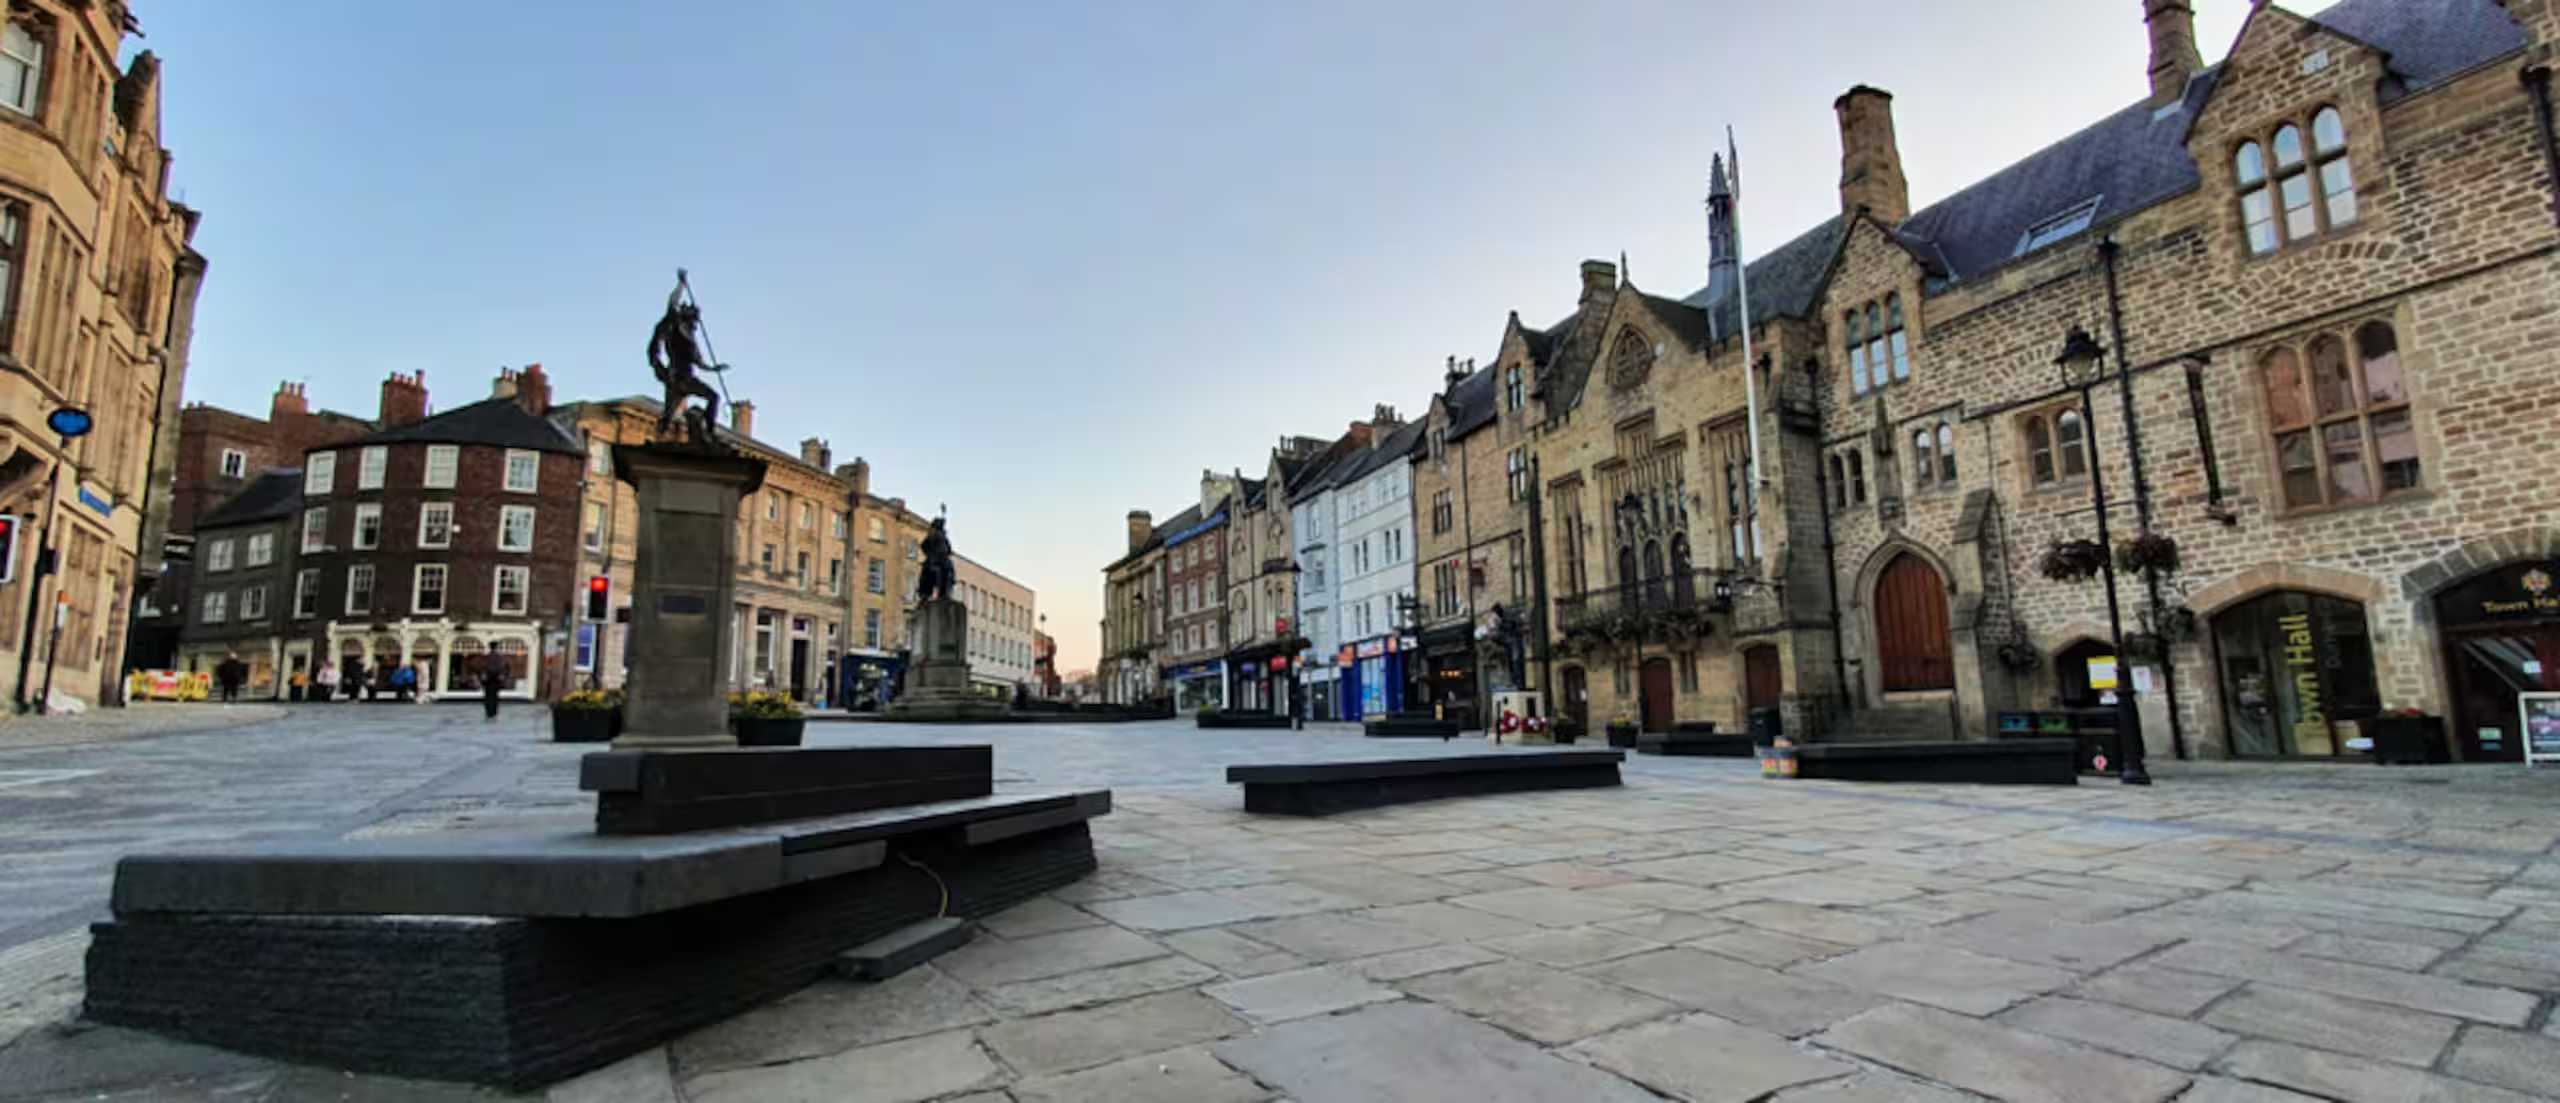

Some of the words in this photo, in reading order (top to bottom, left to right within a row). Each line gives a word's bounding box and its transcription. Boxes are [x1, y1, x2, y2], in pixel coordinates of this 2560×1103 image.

[2481, 600, 2529, 614] Town
[2533, 596, 2560, 609] Ha
[2277, 613, 2316, 666] Hall
